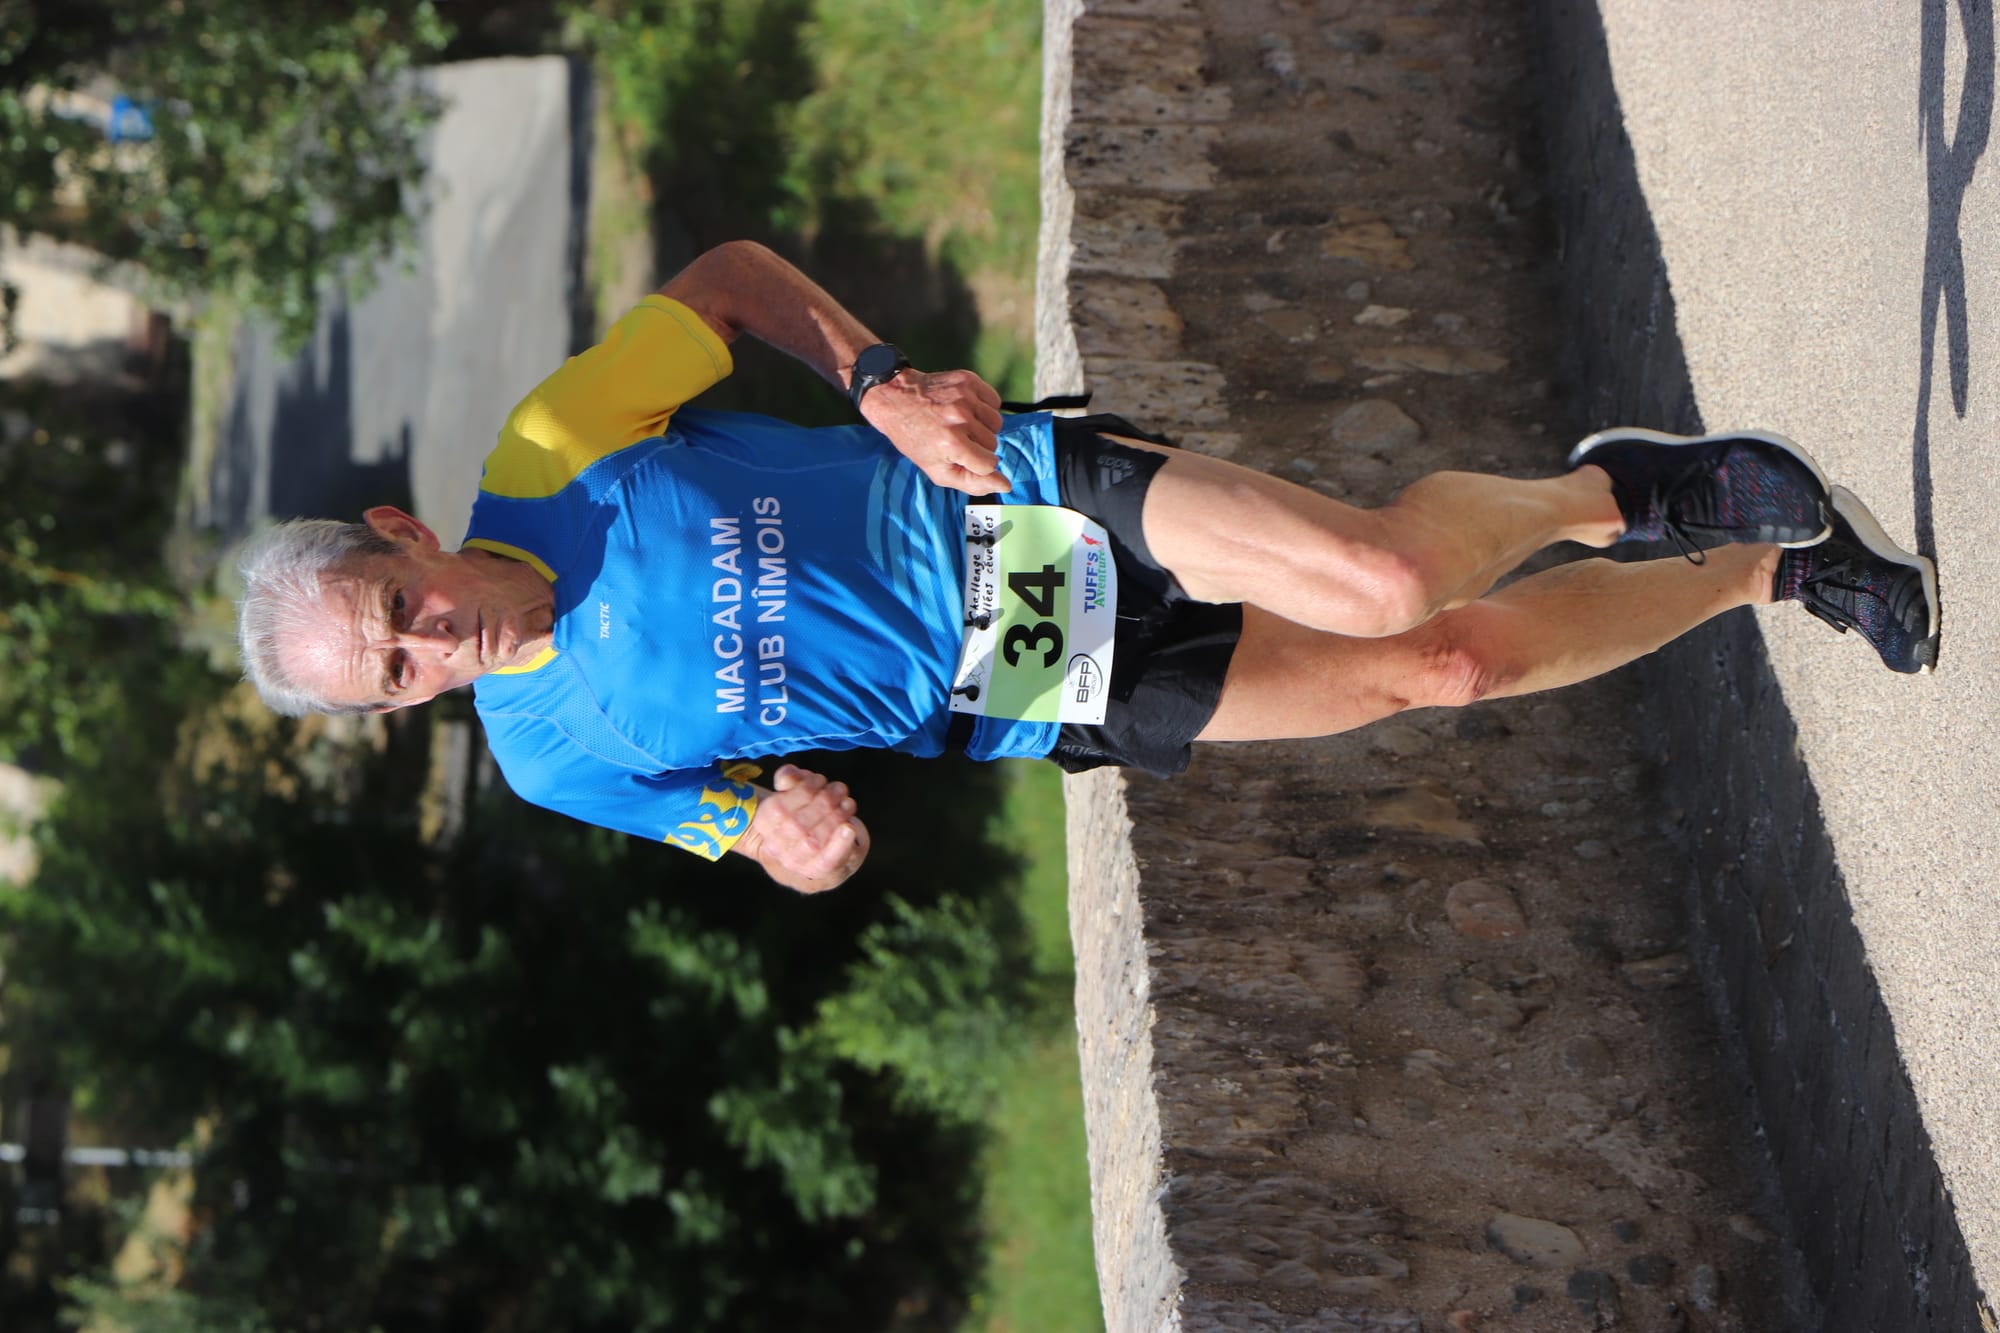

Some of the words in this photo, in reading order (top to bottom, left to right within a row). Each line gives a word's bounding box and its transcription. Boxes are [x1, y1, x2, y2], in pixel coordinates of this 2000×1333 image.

[750, 495, 788, 623] NÎMOIS
[983, 515, 994, 574] céveles
[981, 582, 994, 620] llées
[1084, 551, 1099, 614] TUFF'S
[1093, 549, 1108, 608] Aventure
[599, 601, 611, 640] TACTIC
[709, 516, 746, 714] MACADAM
[1003, 564, 1066, 668] 34
[758, 633, 790, 727] CLUB
[1076, 660, 1093, 703] BFP
